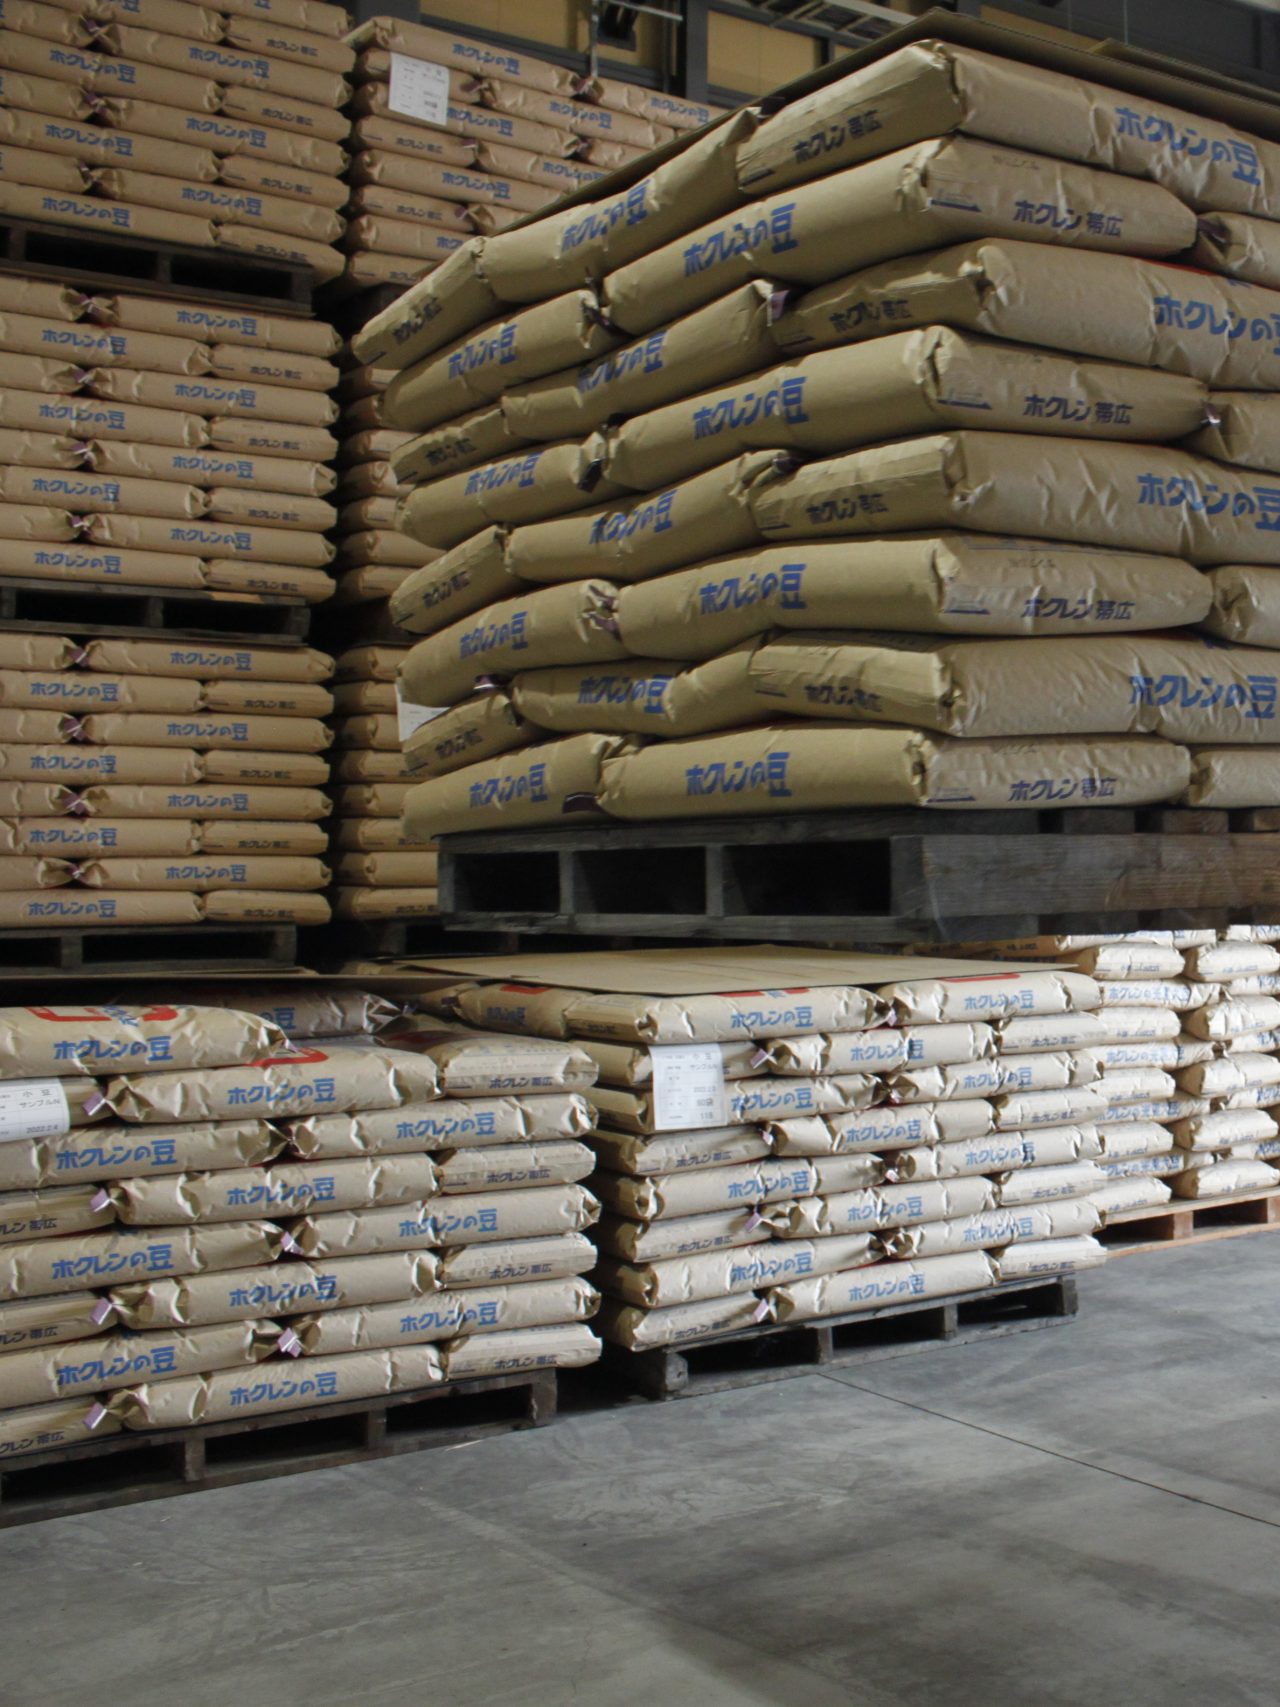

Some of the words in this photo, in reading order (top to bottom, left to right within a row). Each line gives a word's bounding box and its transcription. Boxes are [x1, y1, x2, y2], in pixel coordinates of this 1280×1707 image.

[50, 49, 136, 84] ホクレンの豆
[189, 47, 270, 79] ホクレンの豆
[453, 44, 520, 75] ホクレンの豆
[550, 101, 612, 129] ホクレンの豆
[45, 124, 133, 156] ホクレンの豆
[186, 117, 267, 148] ホクレンの豆
[1116, 107, 1261, 186] ホクレンの豆
[442, 172, 511, 199] ホクレンの豆
[42, 197, 130, 228] ホクレンの豆
[182, 187, 262, 216] ホクレンの豆
[561, 178, 651, 252] ホクレンの豆
[683, 203, 798, 277] ホクレンの豆
[177, 311, 257, 335] ホクレンの豆
[42, 330, 127, 355] ホクレンの豆
[578, 331, 668, 393] ホクレンの豆
[175, 384, 256, 408] ホクレンの豆
[692, 376, 808, 440] ホクレンの豆
[39, 404, 126, 430] ホクレンの豆
[173, 456, 254, 479] ホクレンの豆
[33, 478, 120, 502] ホクレンの豆
[589, 490, 677, 543] ホクレンの豆
[171, 528, 252, 550] ホクレンの豆
[35, 552, 121, 574] ホクレンの豆
[699, 563, 807, 614] ホクレンの豆
[459, 611, 529, 660] ホクレンの豆
[170, 652, 251, 671] ホクレンの豆
[31, 683, 118, 702] ホクレンの豆
[579, 674, 673, 714] ホクレンの豆
[1129, 674, 1277, 719] ホクレンの豆
[168, 723, 248, 741] ホクレンの豆
[31, 755, 116, 774] ホクレンの豆
[686, 752, 792, 797] ホクレンの豆
[168, 794, 248, 811] ホクレンの豆
[30, 829, 117, 847] ホクレンの豆
[165, 865, 246, 882] ホクレンの豆
[28, 901, 117, 919] ホクレンの豆
[731, 1006, 814, 1029] ホクレンの豆
[54, 1036, 173, 1060] ホクレンの豆
[228, 1078, 335, 1104] ホクレンの豆
[731, 1087, 814, 1112] ホクレンの豆
[397, 1112, 496, 1138] ホクレンの豆
[846, 1120, 921, 1142] ホクレンの豆
[57, 1139, 176, 1170] ホクレンの豆
[227, 1177, 335, 1206] ホクレンの豆
[728, 1171, 809, 1198] ホクレンの豆
[399, 1209, 497, 1237] ホクレンの豆
[52, 1244, 173, 1279] ホクレンの豆
[730, 1252, 813, 1281] ホクレンの豆
[229, 1275, 336, 1307] ホクレンの豆
[849, 1274, 925, 1302] ホクレンの豆
[400, 1302, 498, 1333] ホクレンの豆
[57, 1346, 176, 1385] ホクレンの豆
[230, 1372, 337, 1407] ホクレンの豆
